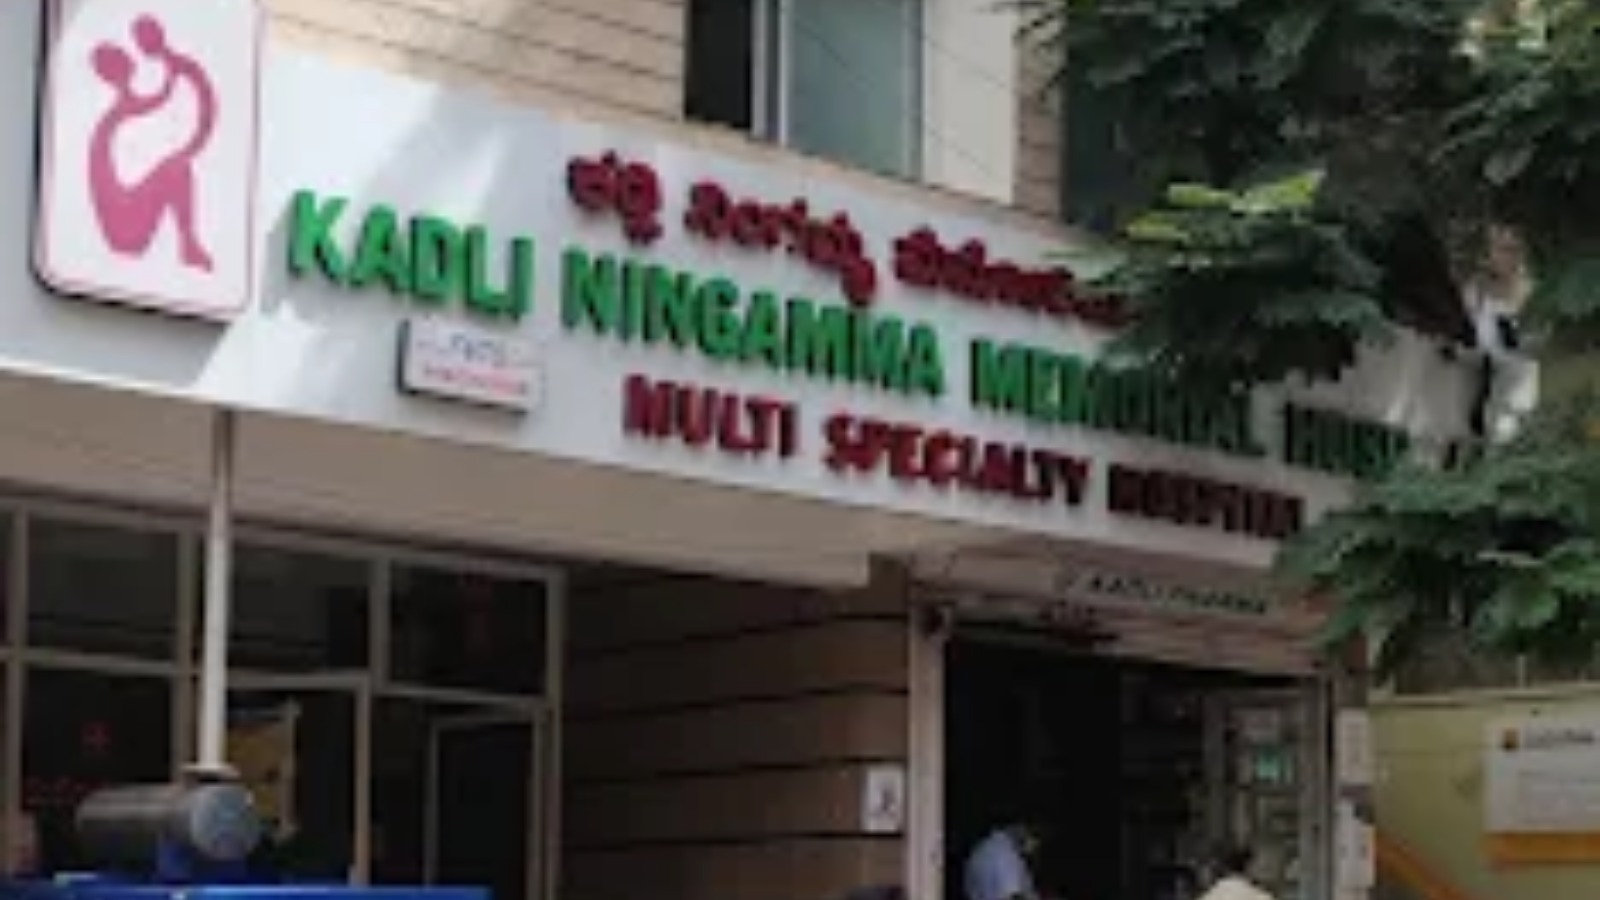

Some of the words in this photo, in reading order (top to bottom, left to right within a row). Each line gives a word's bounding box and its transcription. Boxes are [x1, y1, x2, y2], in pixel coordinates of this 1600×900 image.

[287, 190, 533, 318] KADLI
[560, 245, 943, 396] NINGAMMA
[623, 373, 797, 458] MULTI
[823, 411, 1090, 505] SPECIALTY
